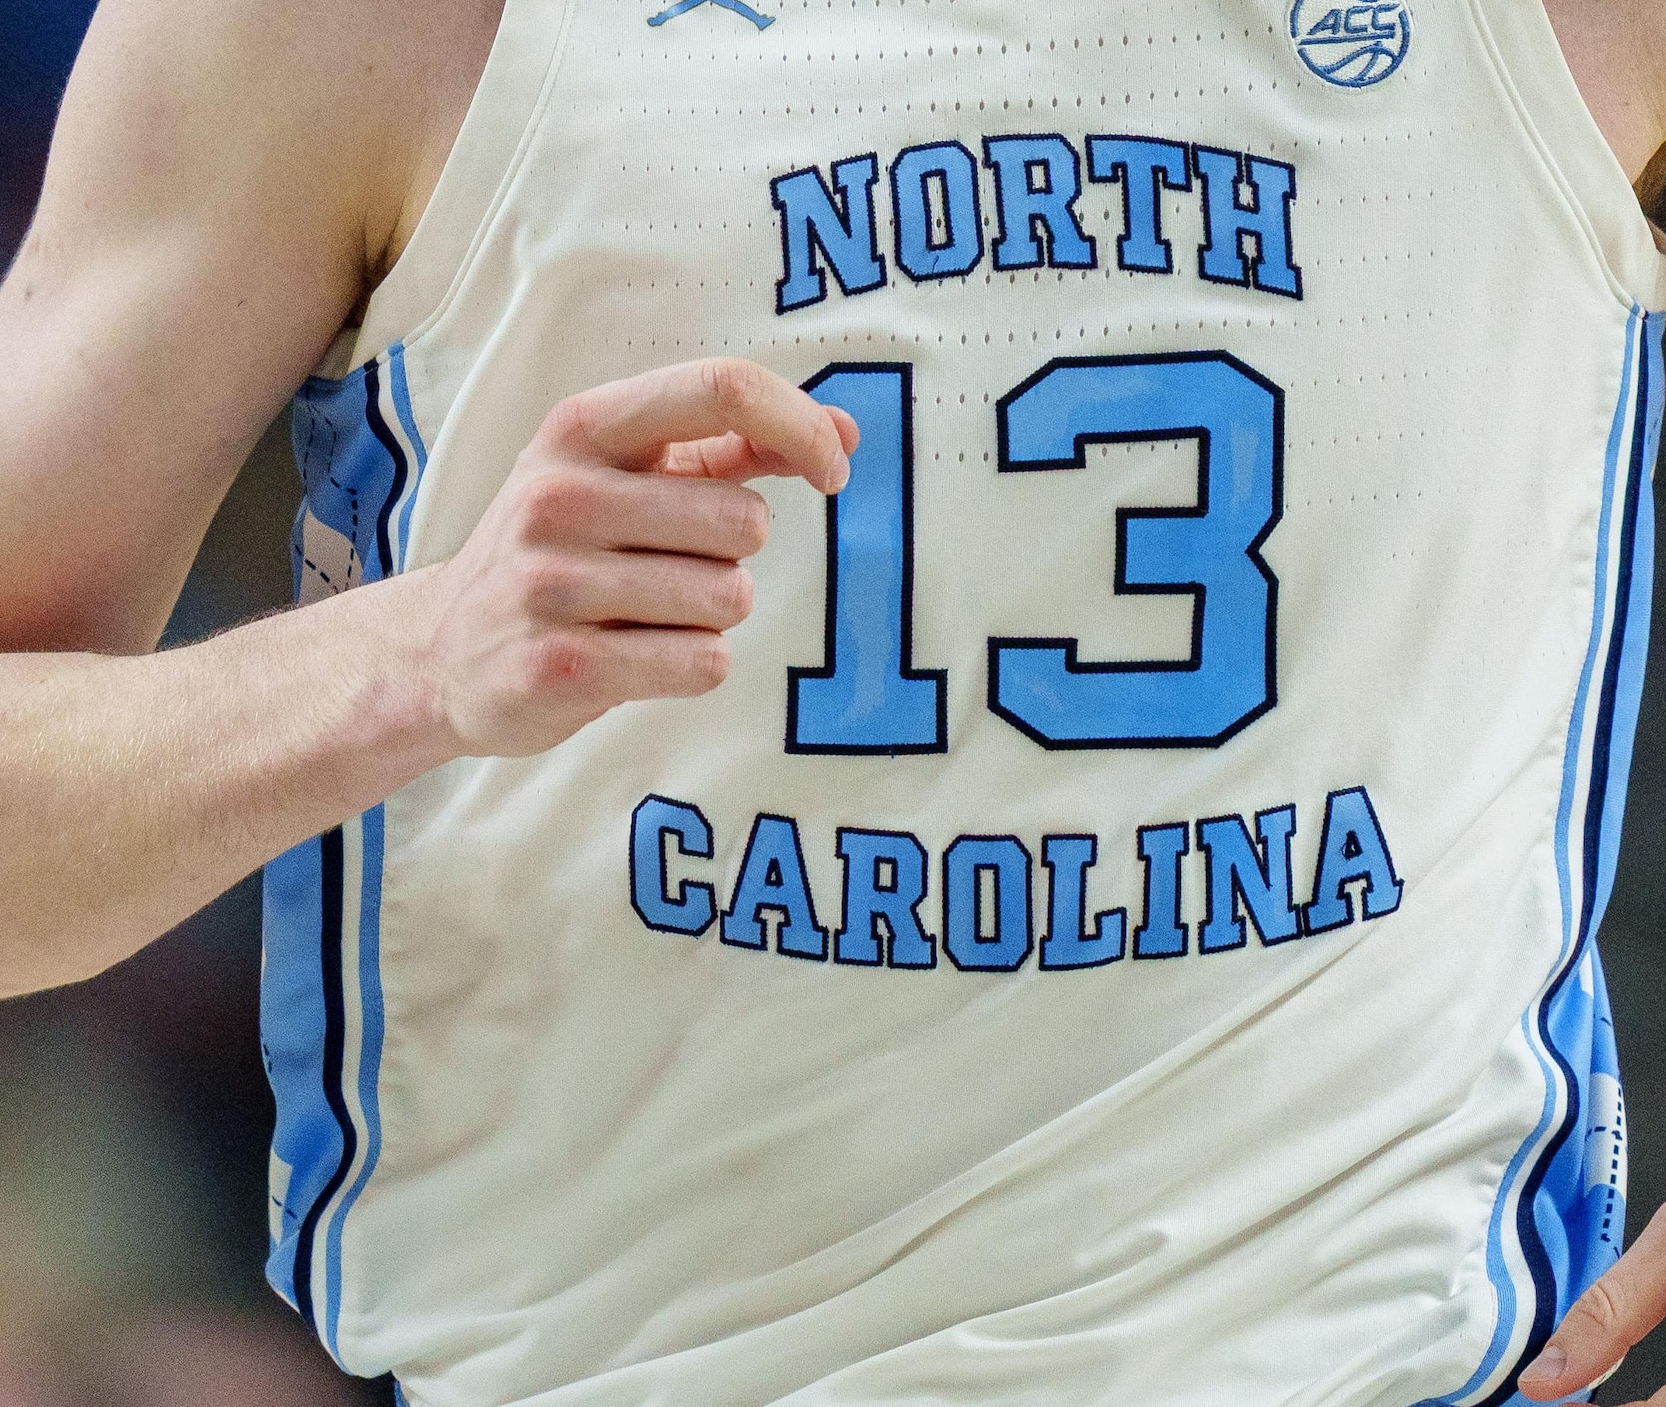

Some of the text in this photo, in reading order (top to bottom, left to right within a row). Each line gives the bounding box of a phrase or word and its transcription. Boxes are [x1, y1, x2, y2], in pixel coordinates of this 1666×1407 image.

[1306, 3, 1400, 35] ACC
[770, 133, 1303, 315] NORTH
[785, 350, 1285, 755] 13
[629, 785, 1404, 972] CAROLINA
